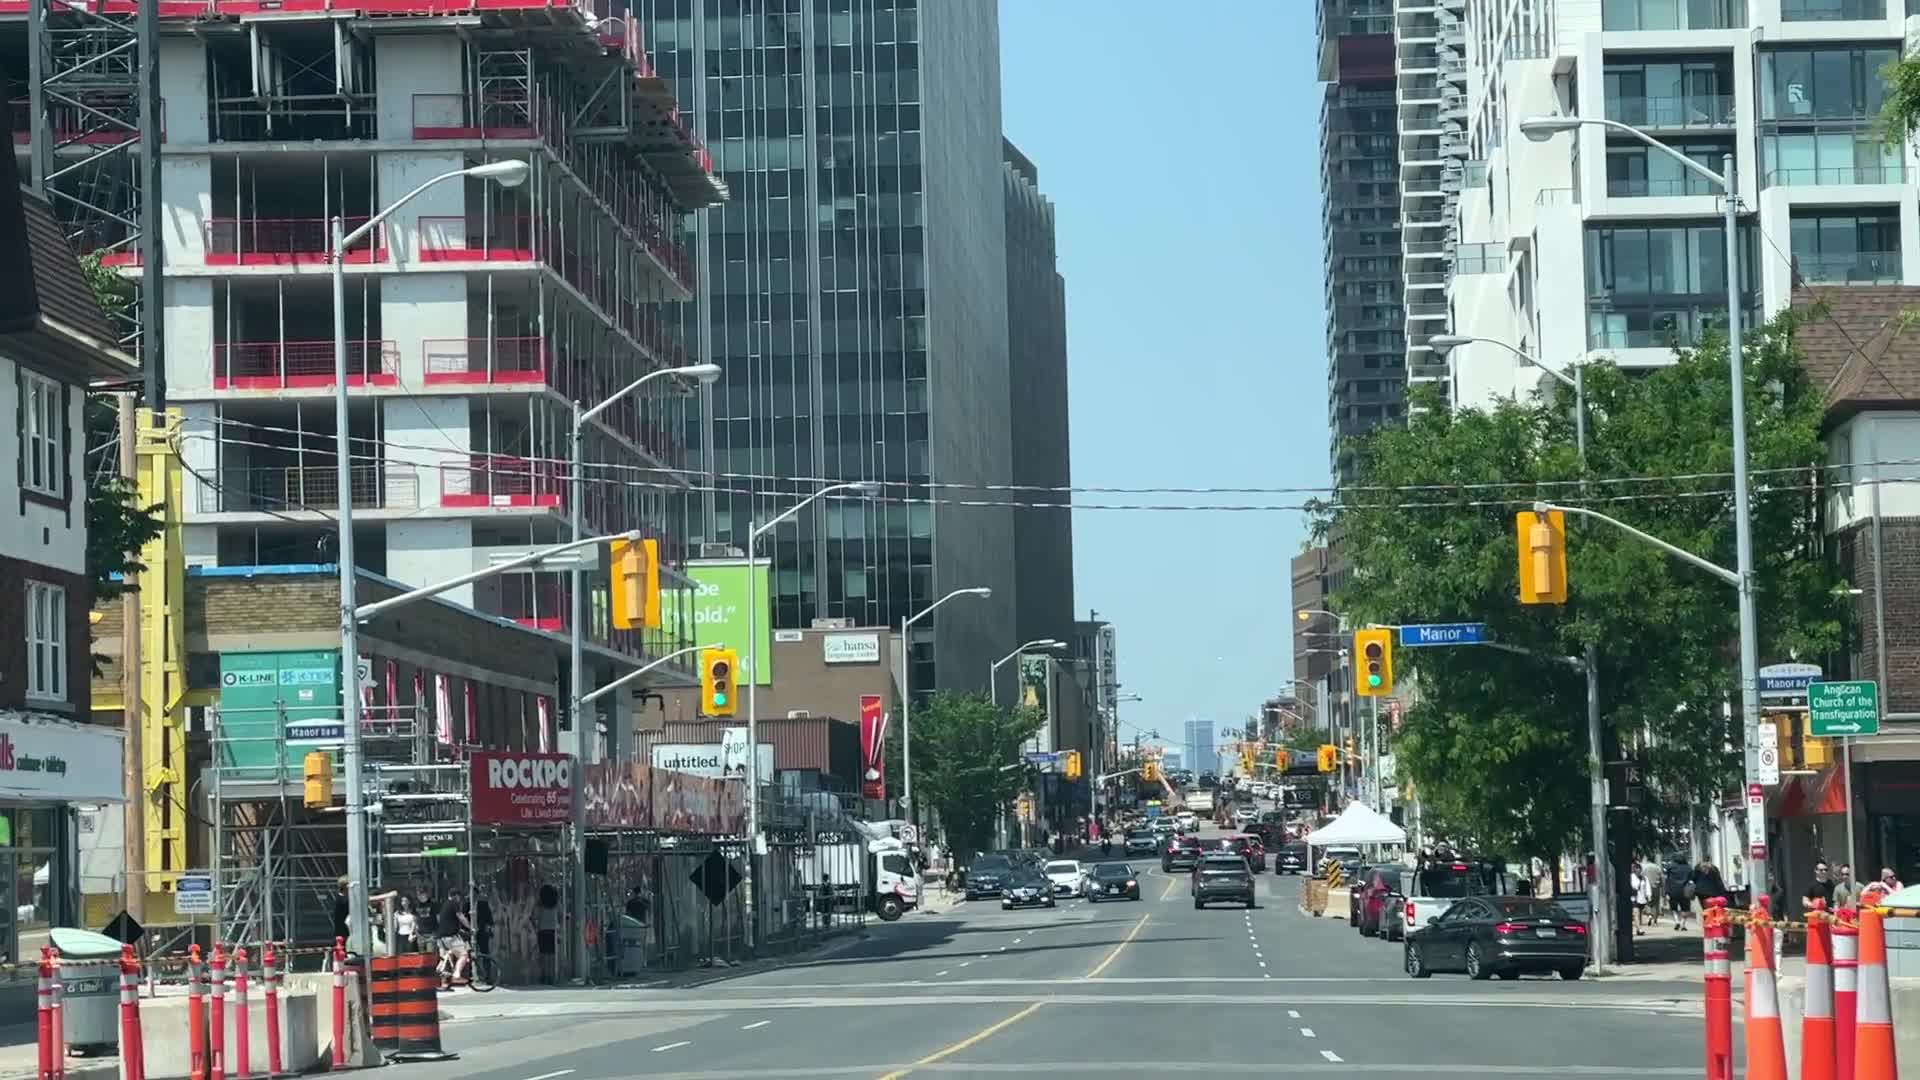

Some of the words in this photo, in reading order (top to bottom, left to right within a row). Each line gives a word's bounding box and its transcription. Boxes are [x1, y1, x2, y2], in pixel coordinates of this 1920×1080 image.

[1420, 628, 1462, 641] Manor
[843, 640, 876, 651] hansa
[239, 673, 275, 682] K-LINE
[1767, 680, 1793, 689] Manor
[1823, 685, 1862, 697] Anglican
[1813, 698, 1844, 708] Church
[1846, 698, 1856, 707] of
[1858, 697, 1873, 706] the
[1812, 710, 1876, 722] Transfiguration
[291, 727, 319, 737] Manor
[664, 755, 720, 768] untitled.
